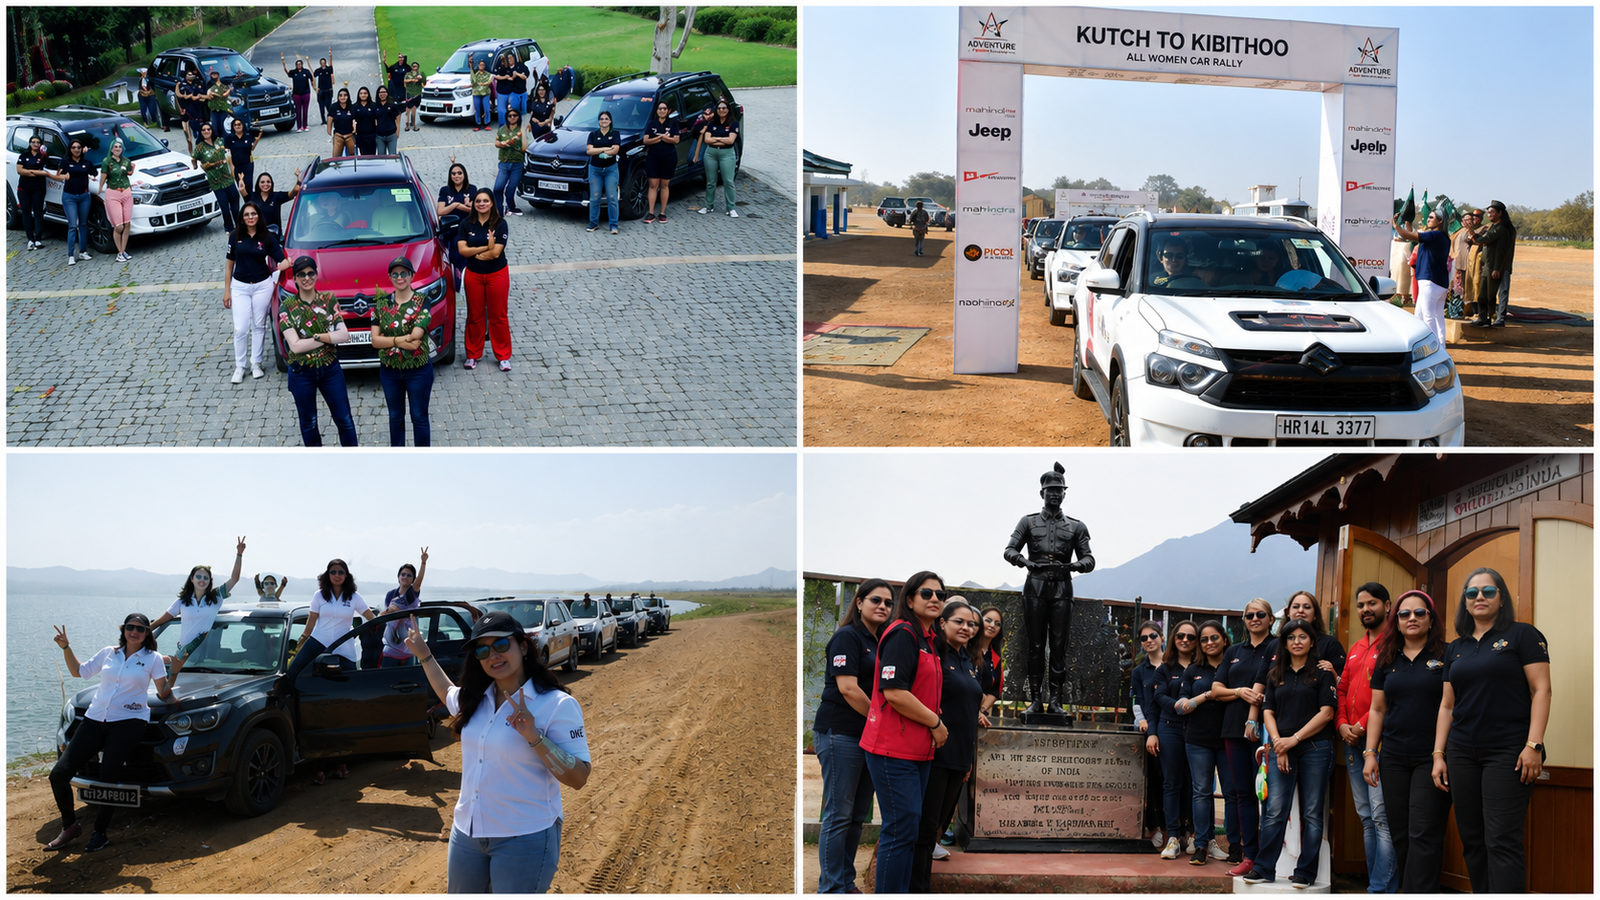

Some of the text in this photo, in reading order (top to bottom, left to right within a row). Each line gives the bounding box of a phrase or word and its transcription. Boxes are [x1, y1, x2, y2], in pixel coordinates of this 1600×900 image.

[968, 40, 1016, 50] ADVENTURE
[1077, 25, 1289, 57] KUTCH TO KIBITHOO
[1126, 53, 1243, 68] ALL WOMEN CAR RALLY
[1348, 66, 1391, 76] ADVENTURE
[968, 123, 1012, 141] Jeep
[1283, 419, 1371, 435] HR14L 3377
[1041, 767, 1053, 775] OF
